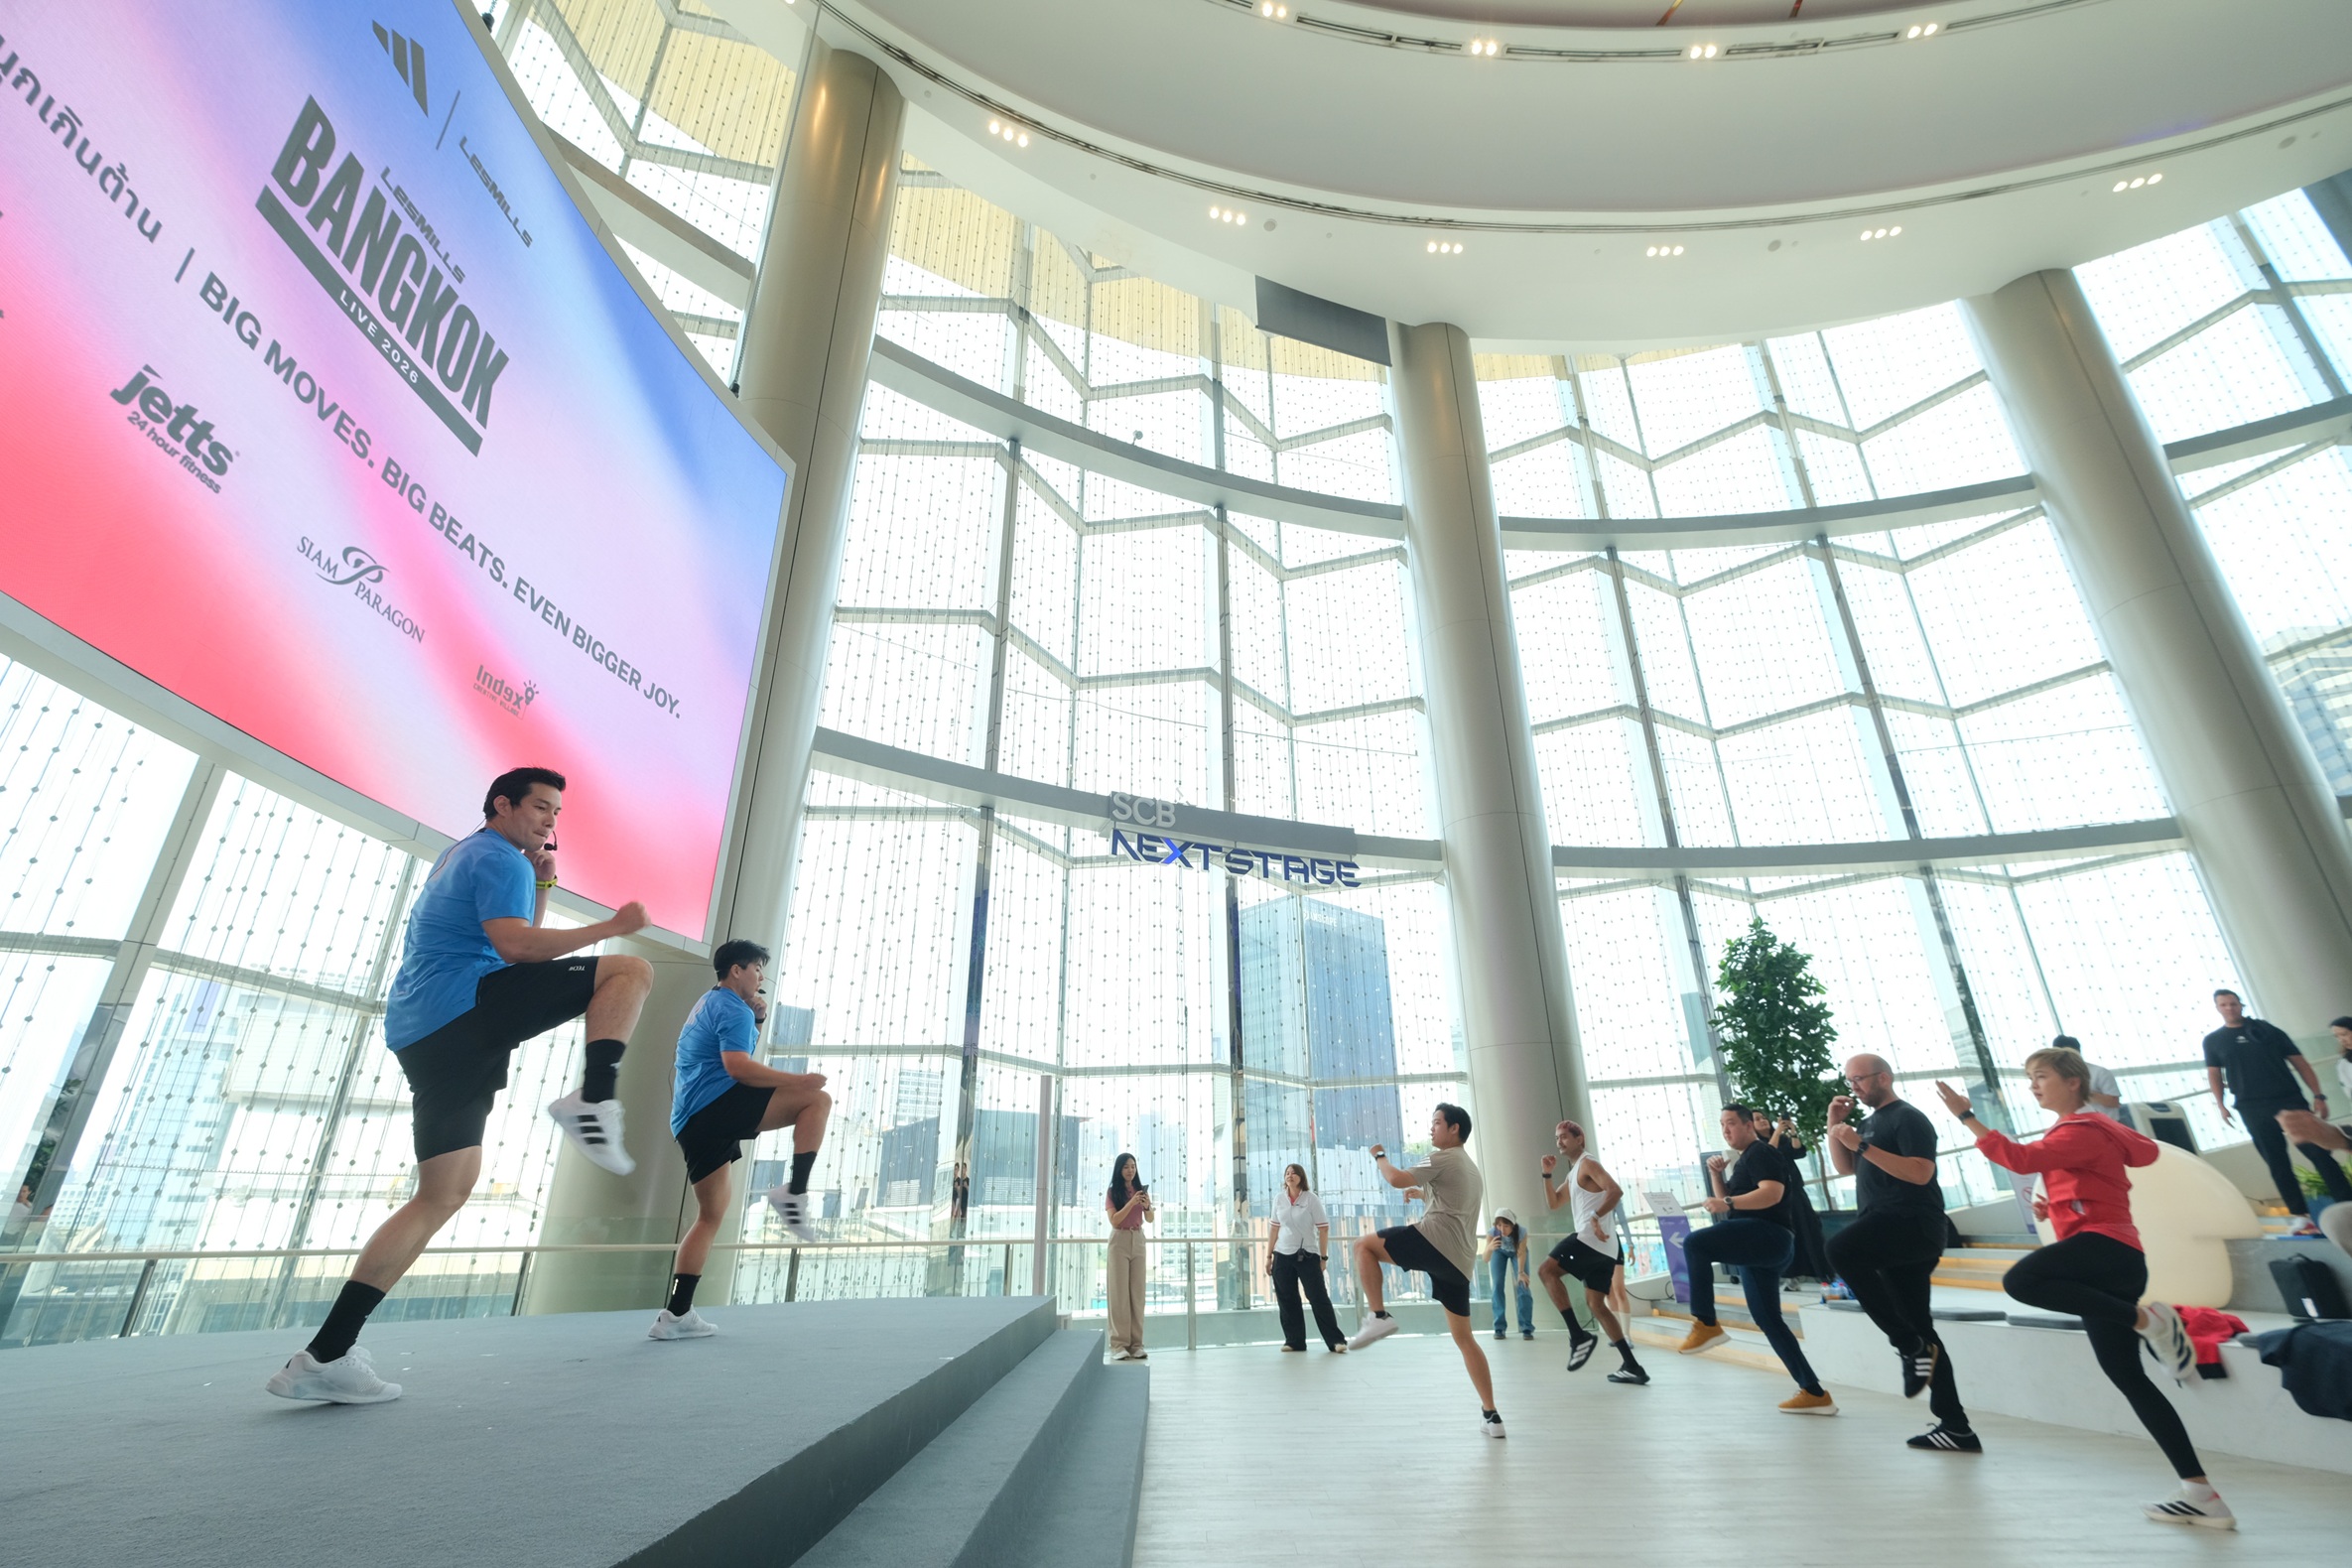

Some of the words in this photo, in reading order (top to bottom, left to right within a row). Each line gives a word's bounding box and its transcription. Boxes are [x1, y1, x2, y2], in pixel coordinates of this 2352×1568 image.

[271, 93, 509, 430] BANGKOK
[339, 290, 378, 337] LIVE
[381, 338, 419, 384] 2026
[110, 363, 233, 476] jetts
[127, 411, 149, 431] 24
[146, 427, 181, 457] hour
[179, 455, 222, 494] fitness
[198, 271, 262, 350] BIG
[263, 338, 375, 468] MOVES.
[381, 457, 427, 514] BIG
[429, 501, 508, 588] BEATS.
[513, 577, 572, 637] EVEN
[573, 625, 643, 691] BIGGER
[643, 683, 681, 719] JOY.
[297, 536, 339, 580] SIAM
[354, 581, 426, 643] PARAGON
[1111, 791, 1176, 829] SCB
[1110, 829, 1224, 871] NEXT
[1224, 848, 1363, 888] STAGE
